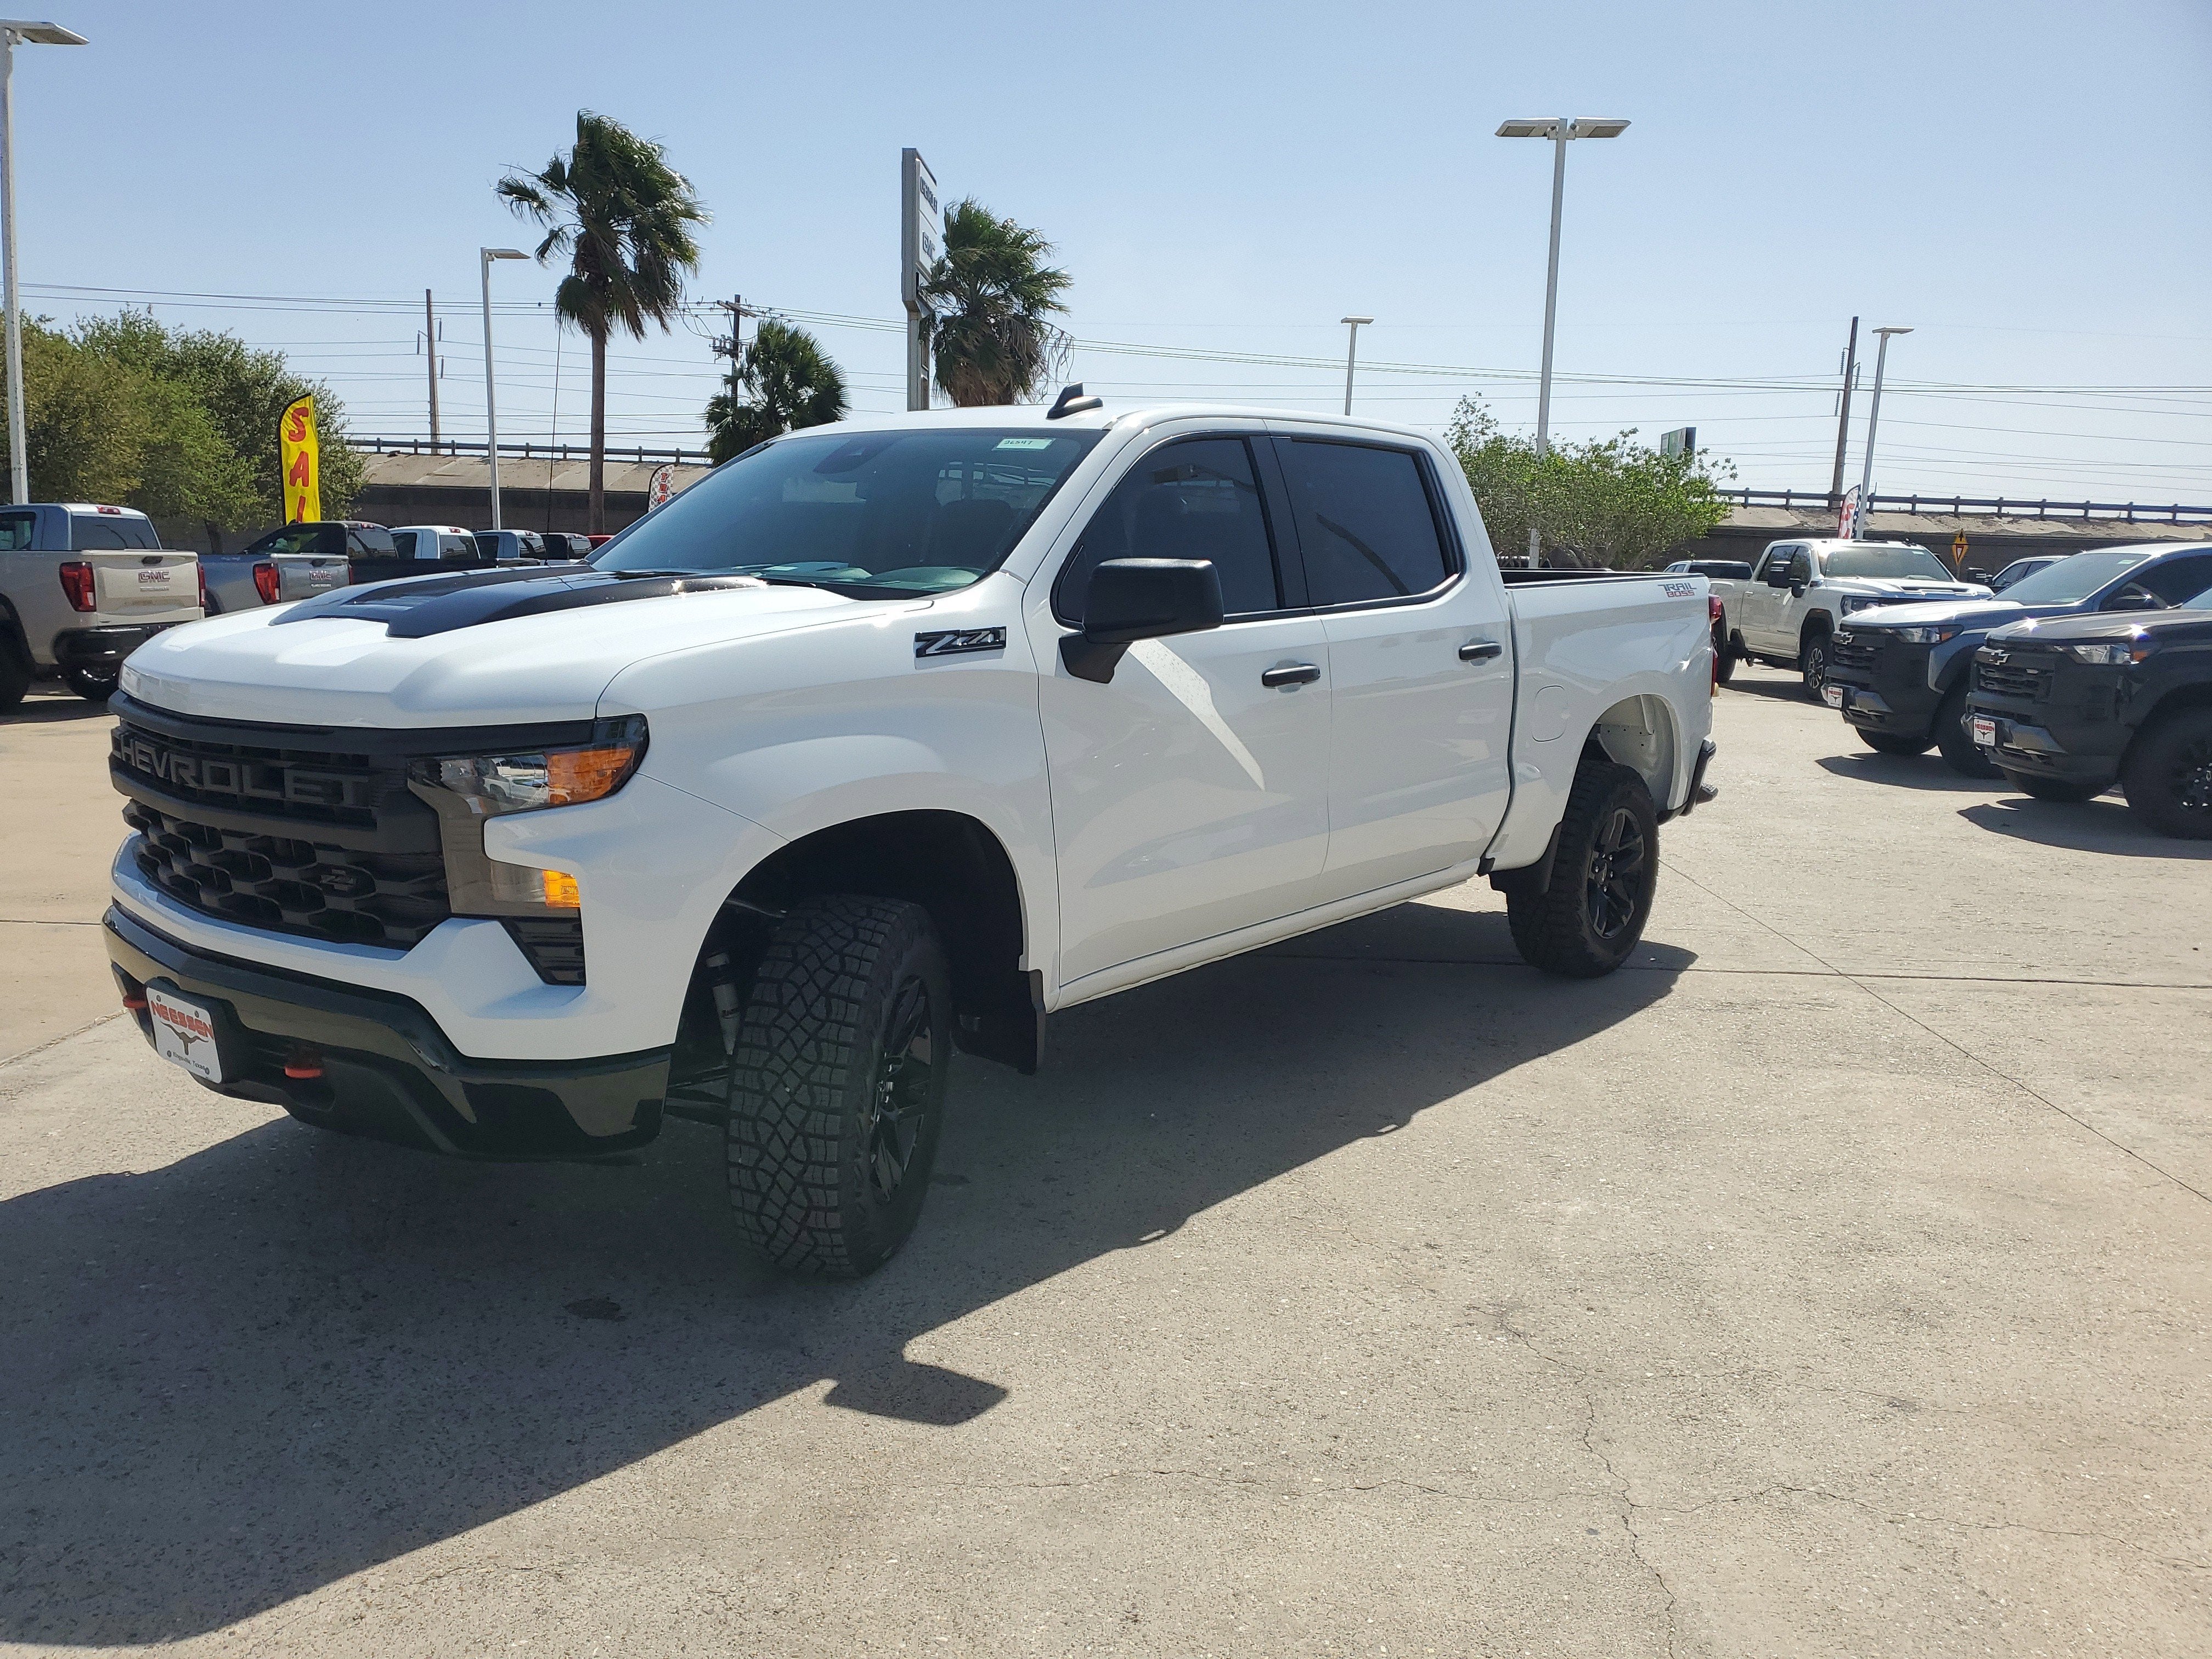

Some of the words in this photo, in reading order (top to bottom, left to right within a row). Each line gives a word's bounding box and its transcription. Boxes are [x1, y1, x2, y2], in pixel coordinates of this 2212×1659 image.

[138, 571, 170, 583] GMC
[1657, 582, 1697, 591] TRAIL
[150, 1000, 215, 1040] NEESSEN
